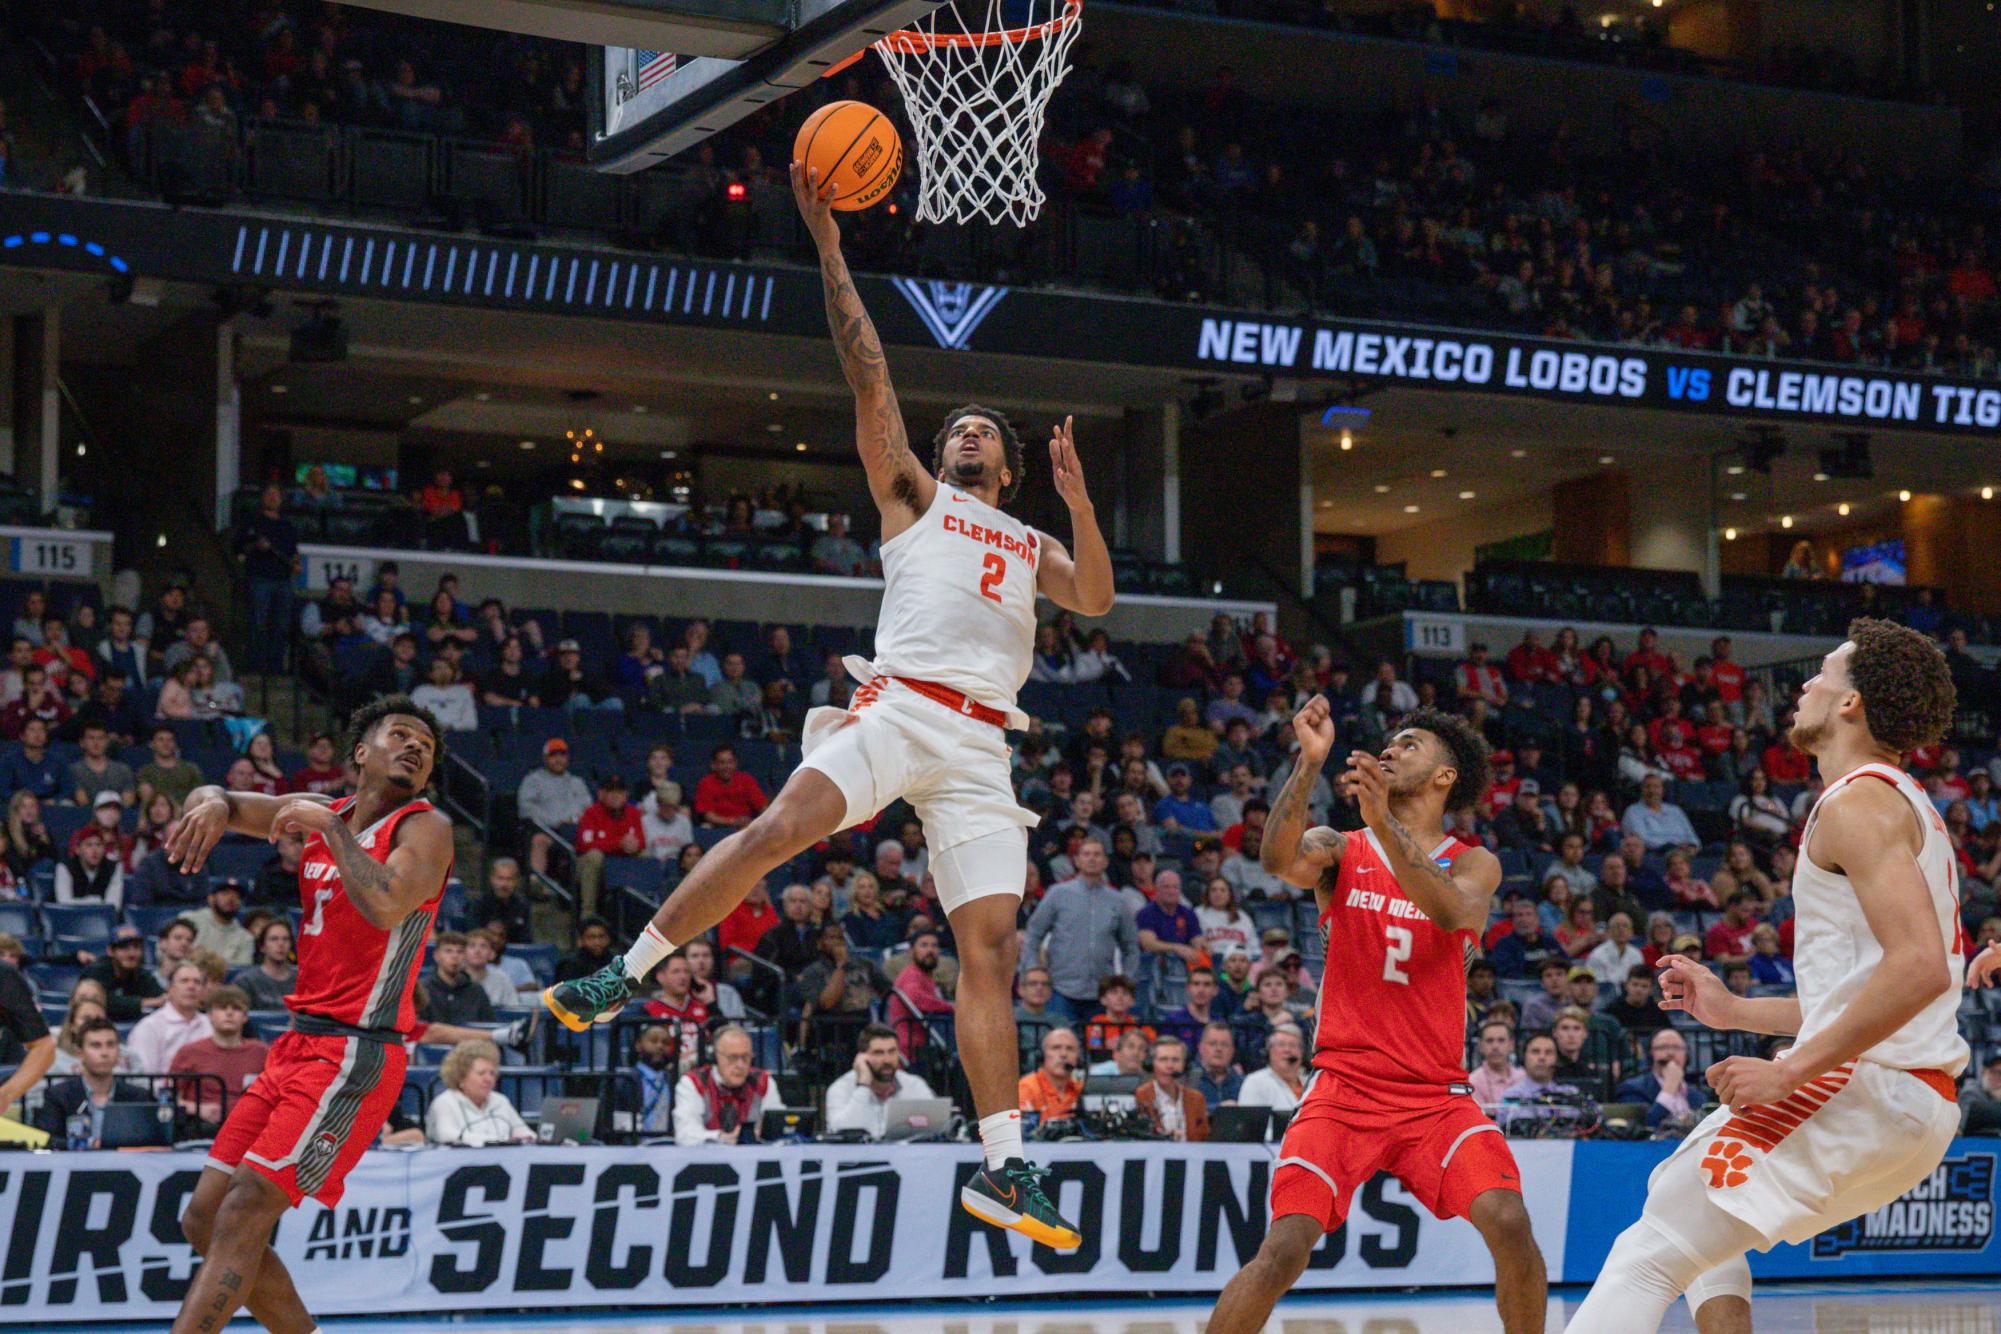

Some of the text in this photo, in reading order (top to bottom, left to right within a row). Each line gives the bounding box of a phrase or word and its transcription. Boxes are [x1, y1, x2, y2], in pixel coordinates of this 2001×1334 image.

[1198, 317, 1302, 367] NEW
[1311, 329, 1494, 384] MEXICO
[1505, 347, 1648, 398] LOBOS
[1666, 366, 1712, 401] VS
[1726, 367, 1922, 421] CLEMSON
[37, 544, 76, 570] 115
[943, 514, 1036, 571] CLEMSON
[980, 552, 1006, 603] 2
[1423, 626, 1451, 647] 113
[1345, 888, 1386, 912] NEW
[1383, 925, 1413, 985] 2
[0, 1158, 1420, 1305] IRS AND SECOND ROUNS
[1864, 1201, 1991, 1238] MADNESS
